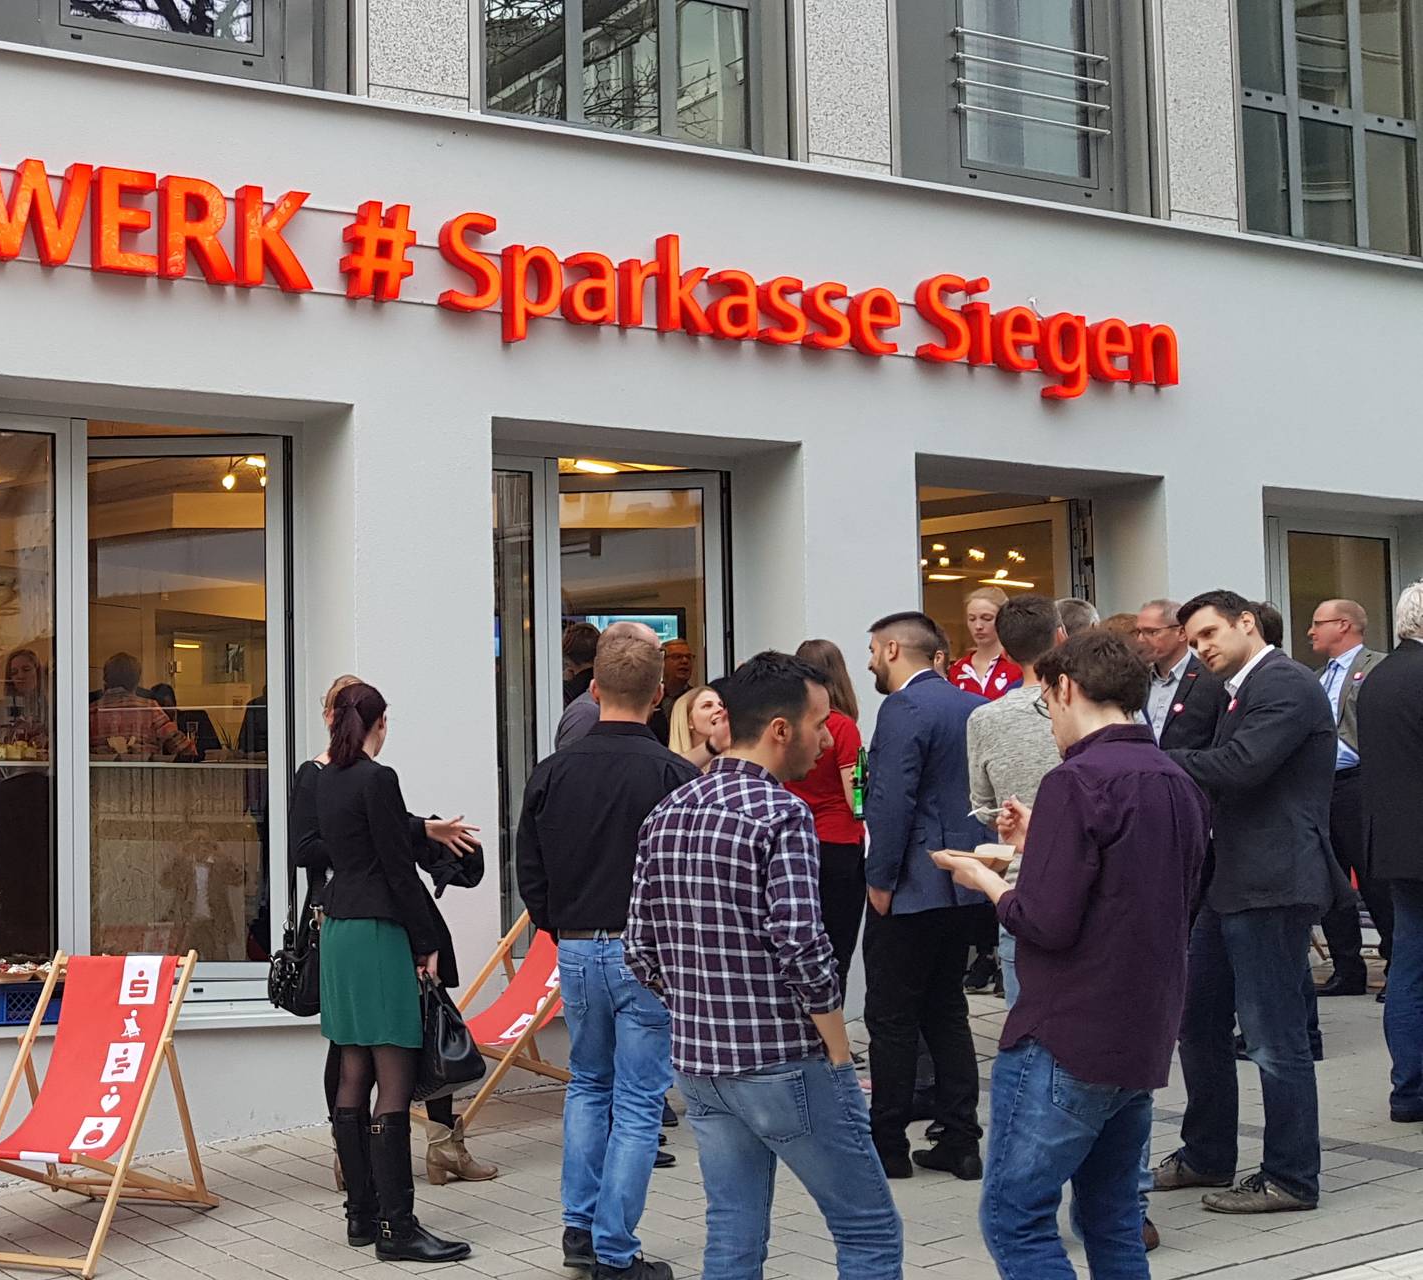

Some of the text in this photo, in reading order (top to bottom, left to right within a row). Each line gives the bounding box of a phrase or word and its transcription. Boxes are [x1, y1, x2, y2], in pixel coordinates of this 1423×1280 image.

[339, 200, 417, 303] #
[438, 212, 901, 357] Sparkasse
[915, 273, 1179, 400] Siegen
